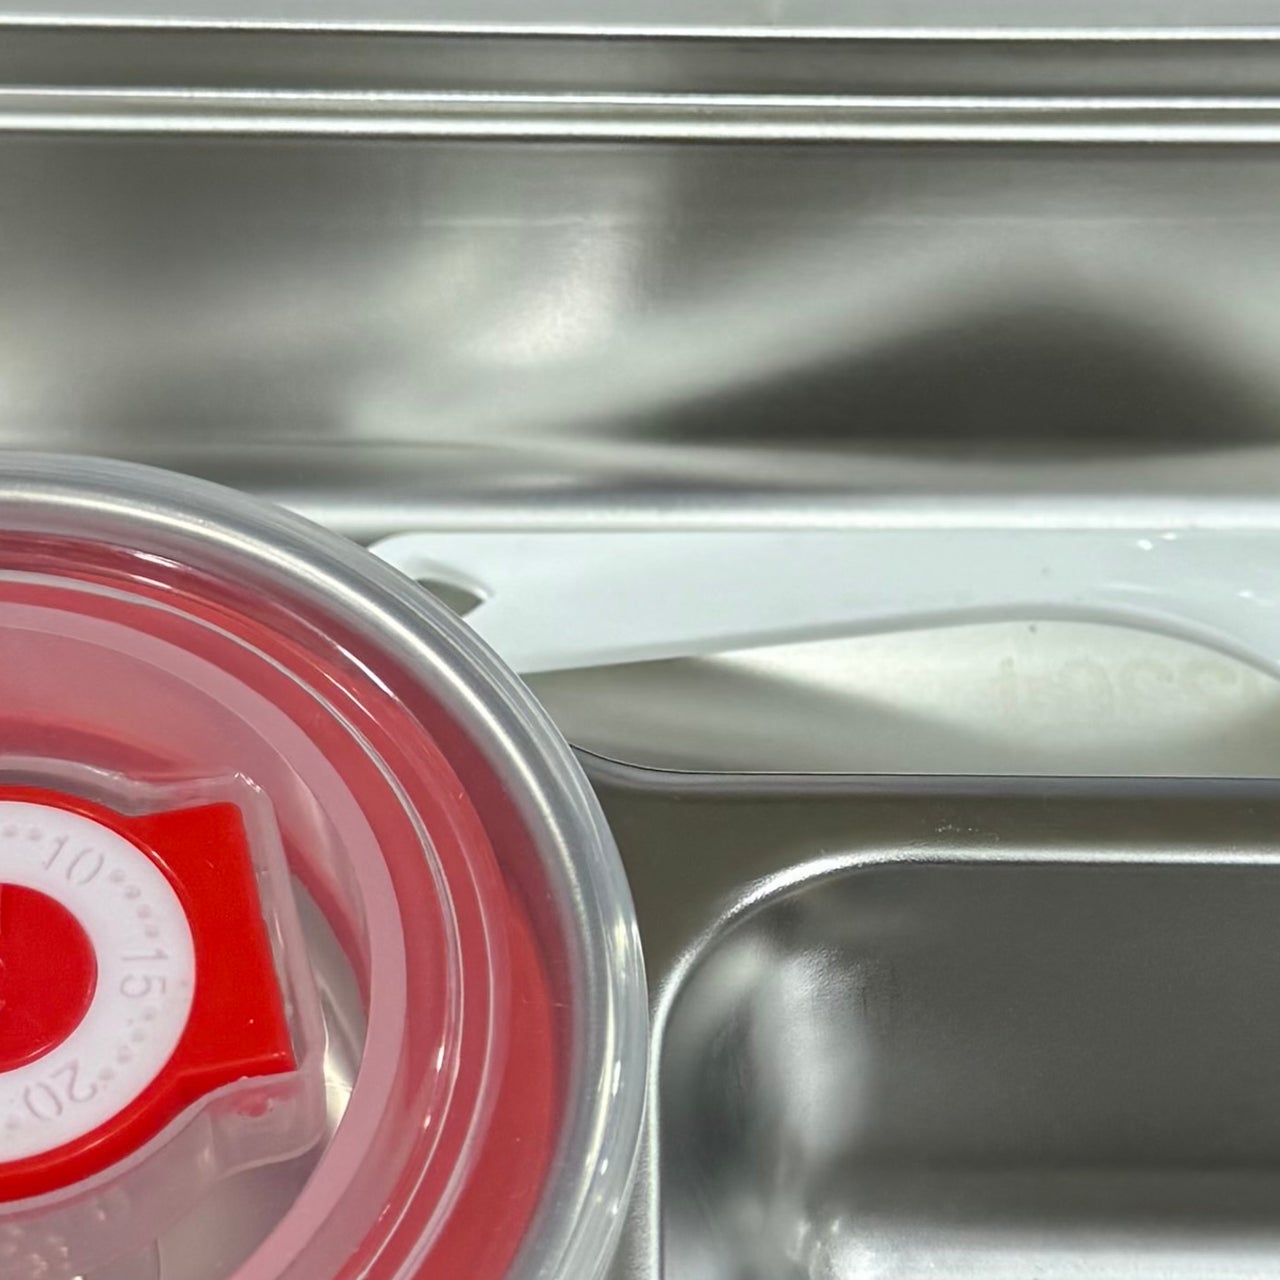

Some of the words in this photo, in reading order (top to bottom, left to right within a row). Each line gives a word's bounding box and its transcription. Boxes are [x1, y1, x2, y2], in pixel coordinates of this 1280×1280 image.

[41, 833, 106, 888] 10
[120, 946, 169, 999] 15
[21, 1056, 99, 1122] 20
